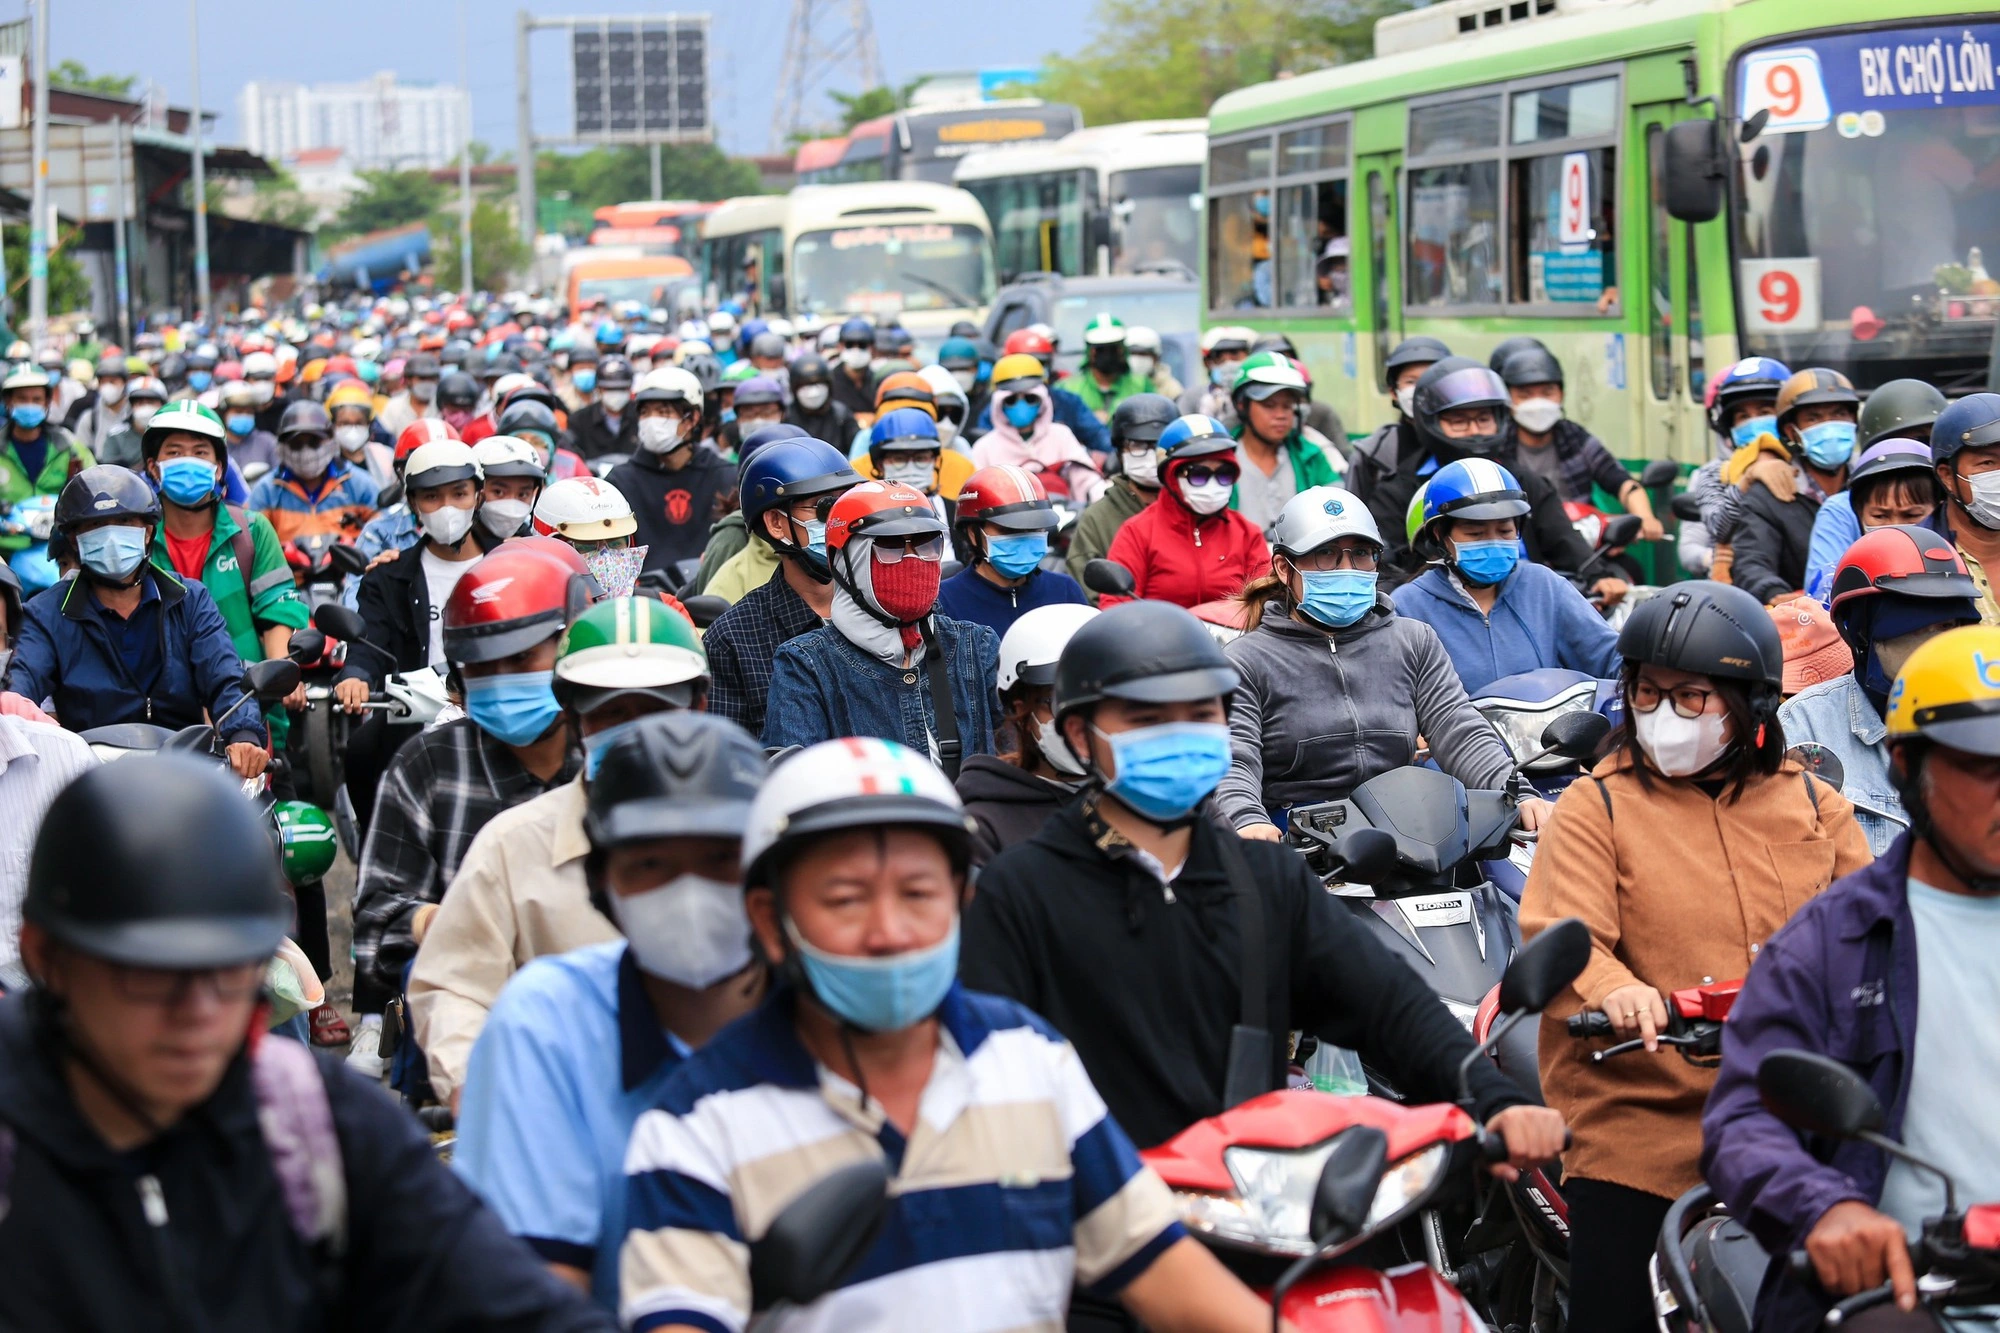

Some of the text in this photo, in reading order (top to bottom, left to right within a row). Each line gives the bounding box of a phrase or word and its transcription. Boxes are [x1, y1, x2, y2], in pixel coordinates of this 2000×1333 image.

[1765, 64, 1803, 117] 9
[1860, 46, 1896, 97] BX
[1895, 37, 1945, 104] CHỢ
[1568, 163, 1582, 234] 9
[1757, 269, 1802, 323] 9
[1417, 901, 1461, 911] HONDA
